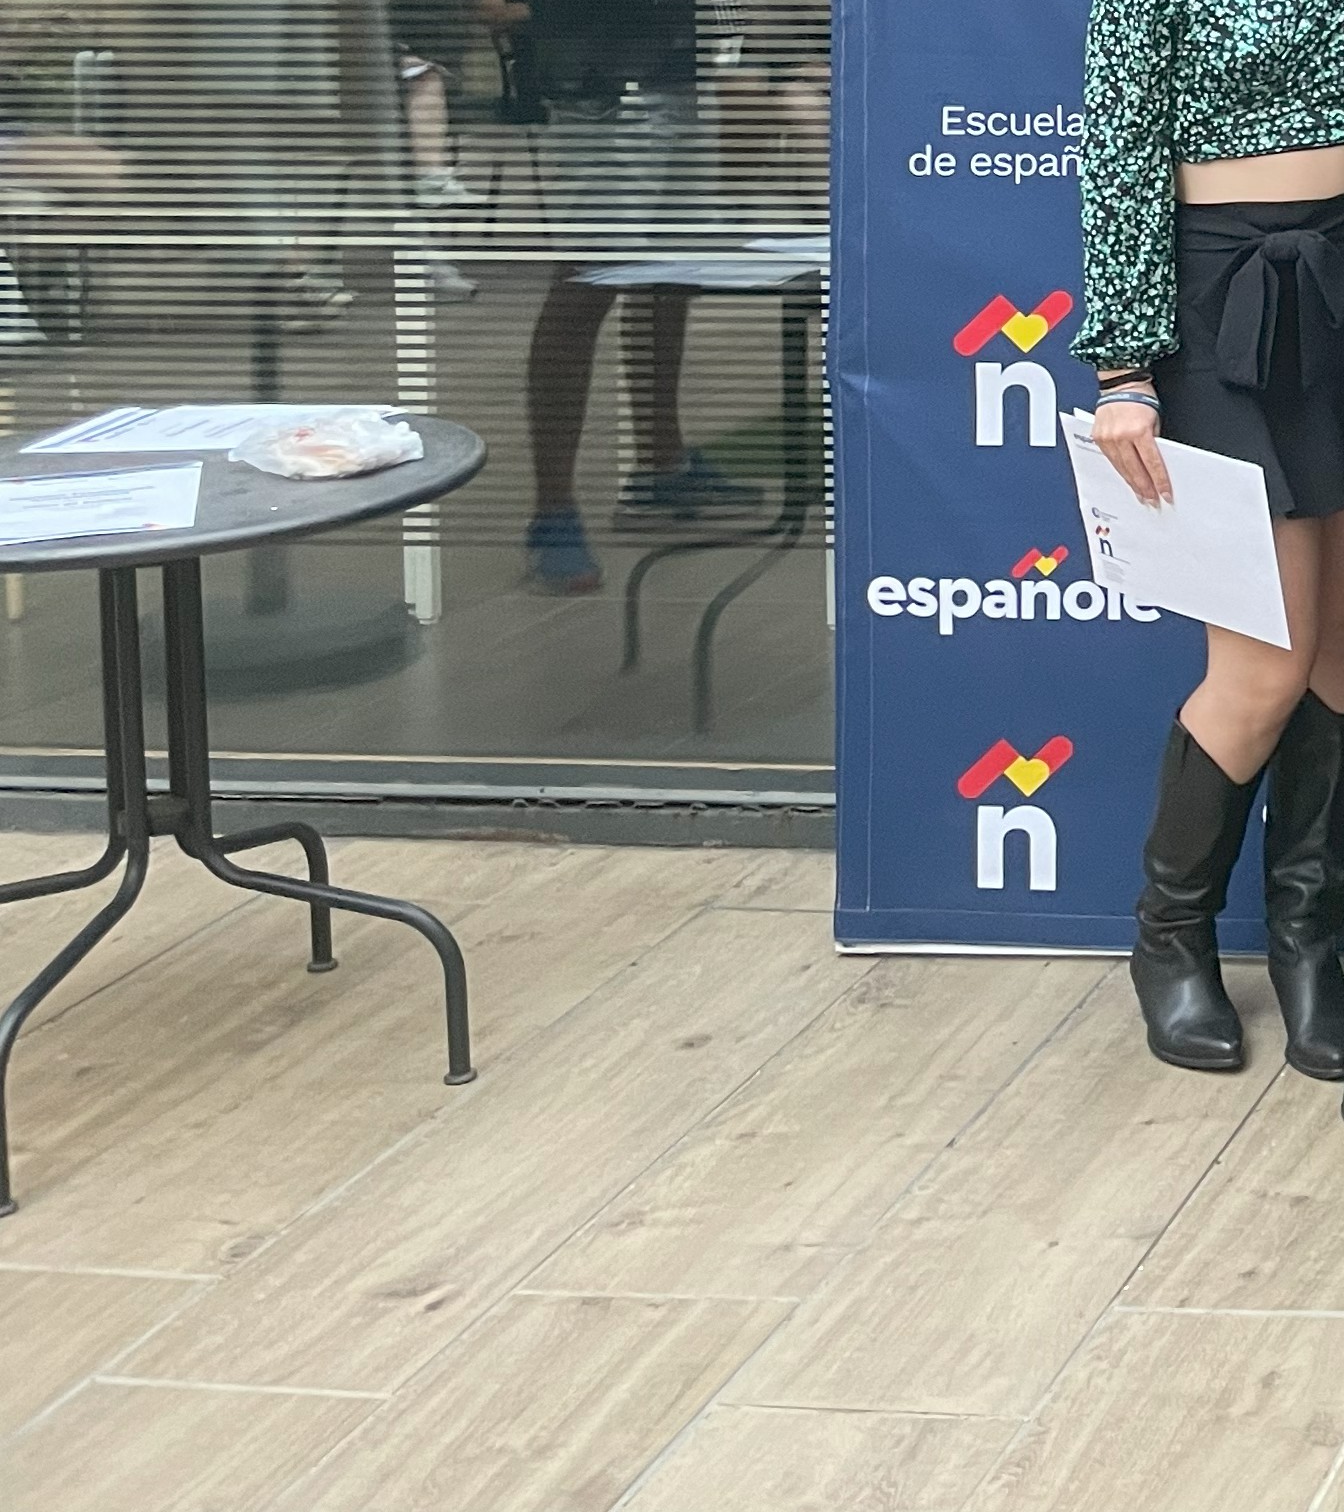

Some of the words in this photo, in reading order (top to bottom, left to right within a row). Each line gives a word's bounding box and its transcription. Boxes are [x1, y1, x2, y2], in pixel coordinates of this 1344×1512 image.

[942, 104, 1084, 137] Escuela
[908, 144, 957, 178] de
[970, 145, 1083, 185] españ
